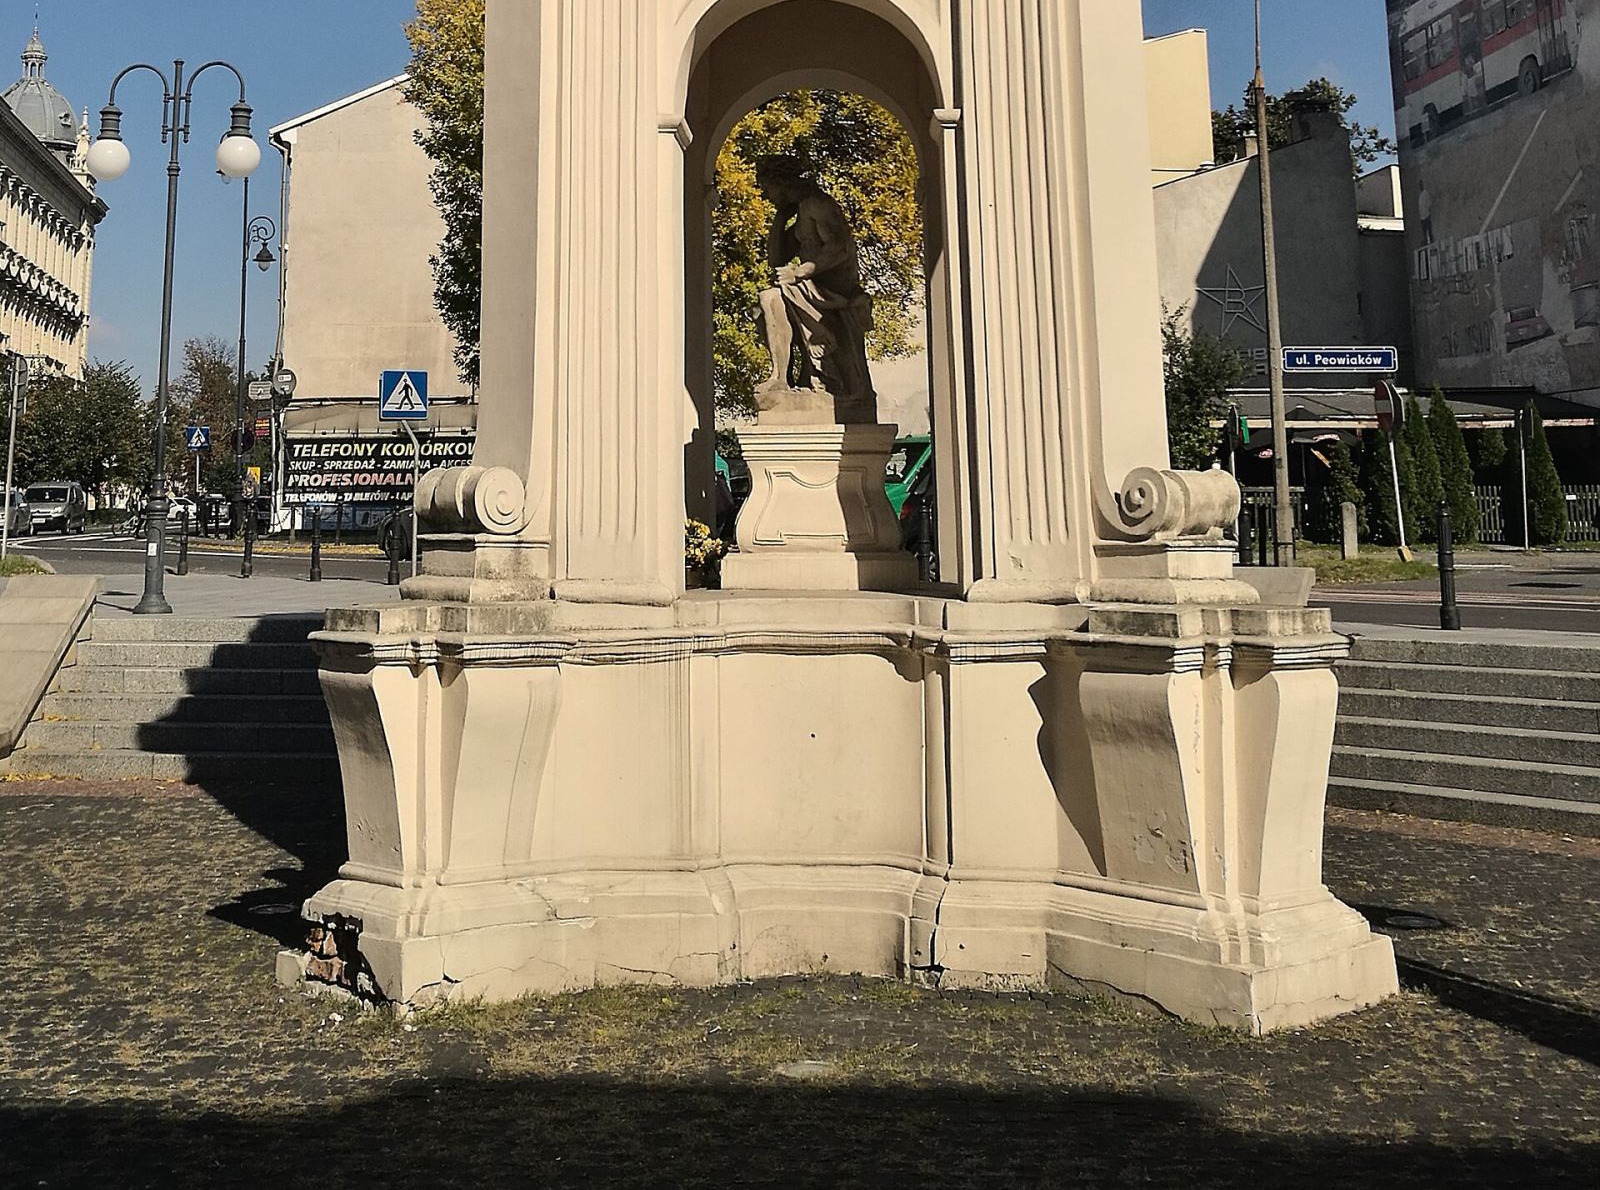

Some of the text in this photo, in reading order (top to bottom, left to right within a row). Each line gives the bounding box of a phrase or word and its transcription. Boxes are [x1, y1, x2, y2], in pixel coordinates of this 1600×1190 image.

[1295, 354, 1382, 365] ul. Peowiaków
[293, 440, 473, 457] TELEFONY KOMÓRKO
[288, 460, 316, 470] SKUP
[323, 458, 376, 470] SPRZEDAŻ
[382, 459, 431, 469] ZAMIANA
